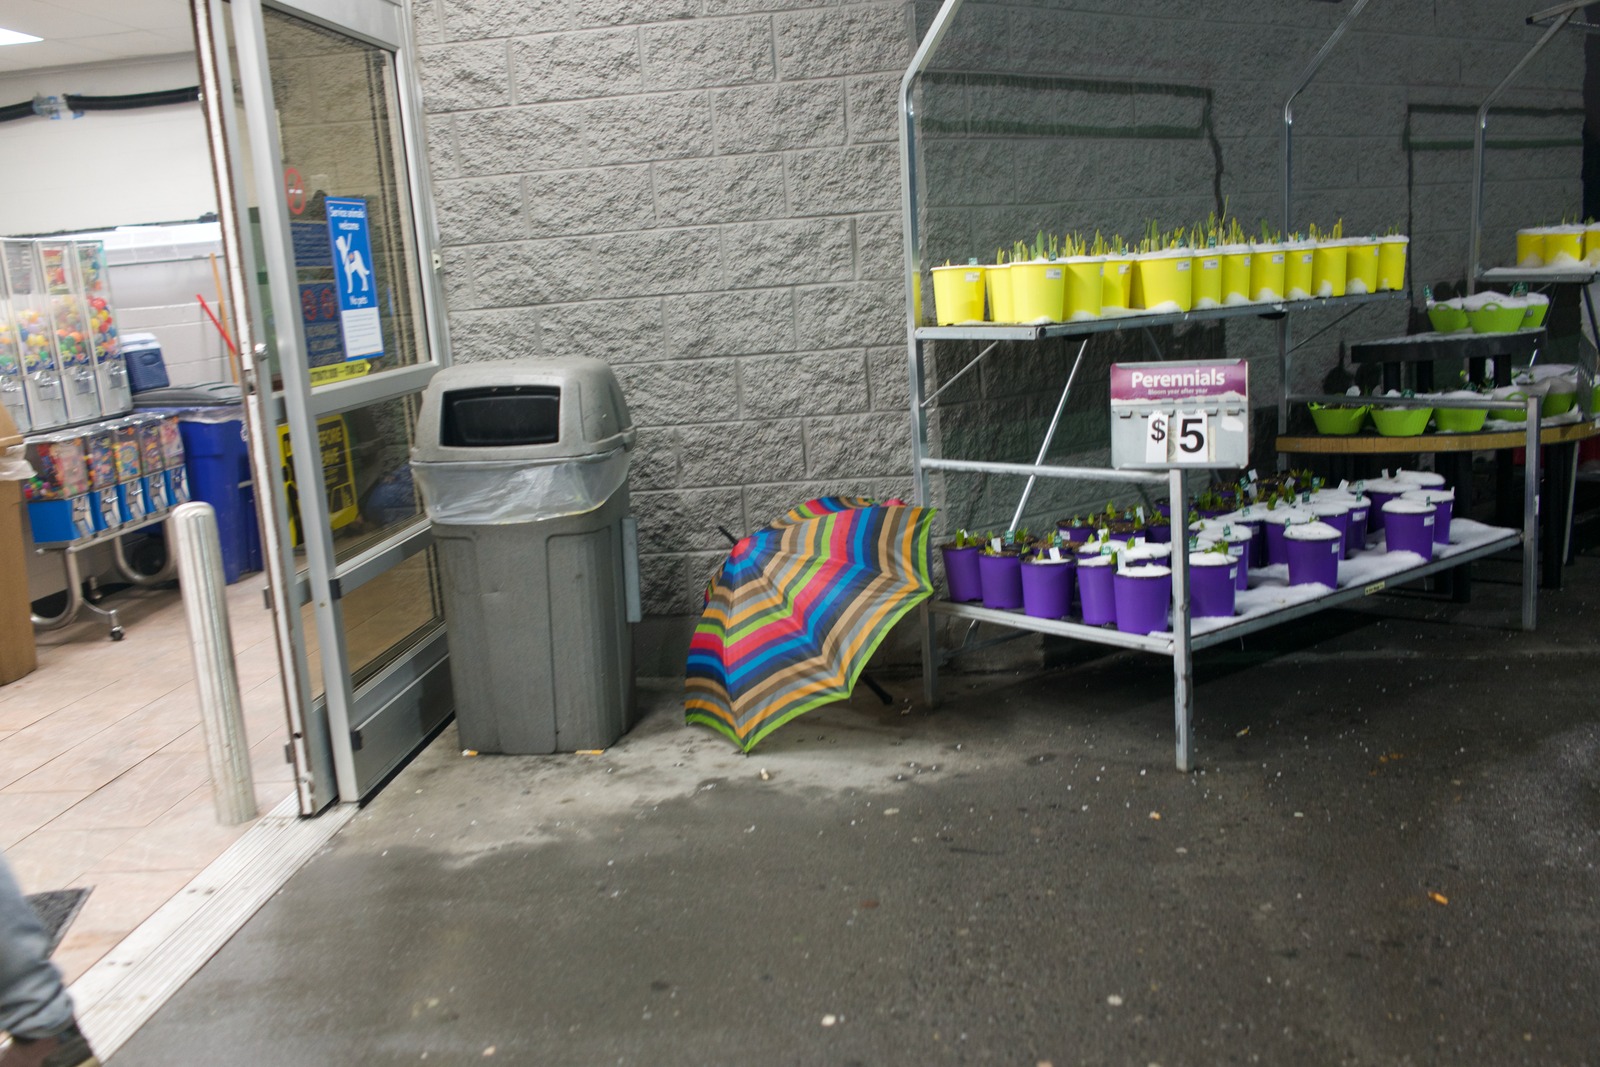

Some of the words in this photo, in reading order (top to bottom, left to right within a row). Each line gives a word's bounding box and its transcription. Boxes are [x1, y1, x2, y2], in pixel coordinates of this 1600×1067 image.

[1131, 368, 1226, 388] Perennials
[1195, 388, 1208, 396] year
[1179, 418, 1205, 453] 5
